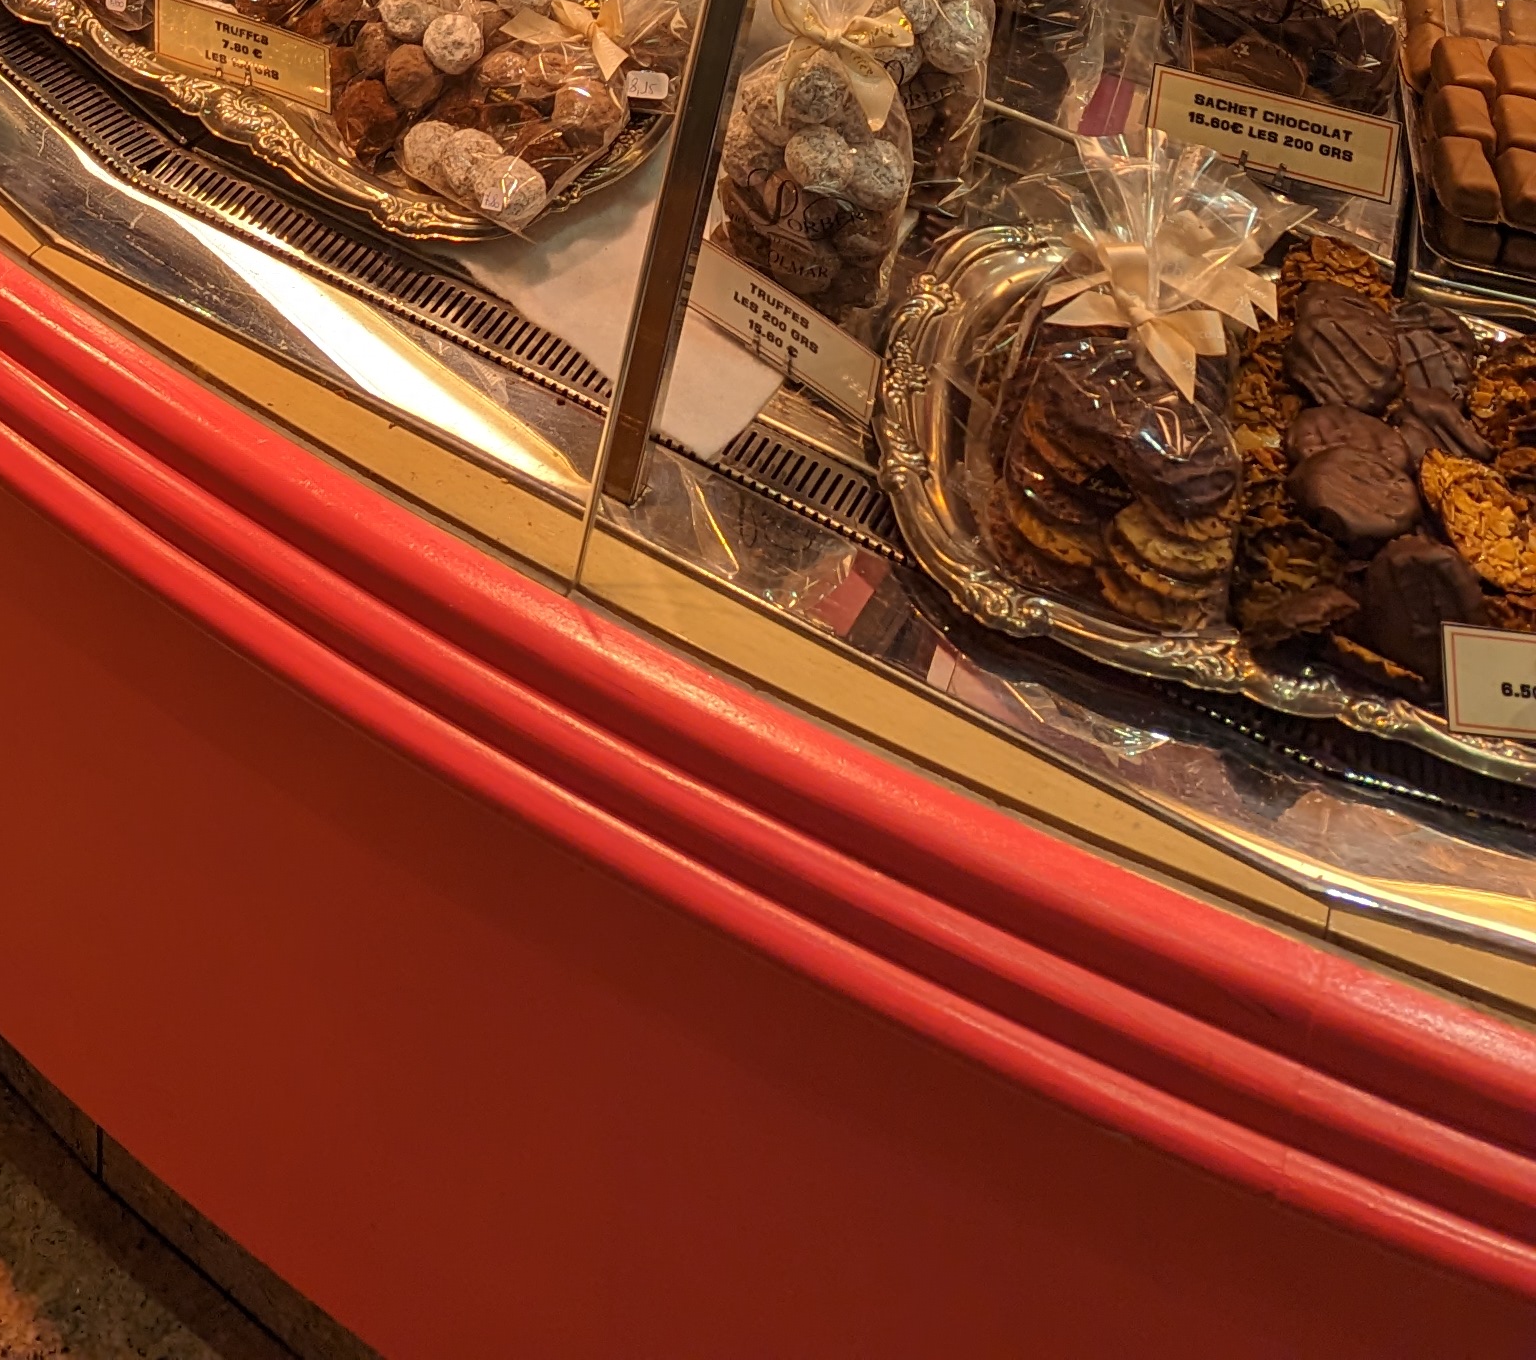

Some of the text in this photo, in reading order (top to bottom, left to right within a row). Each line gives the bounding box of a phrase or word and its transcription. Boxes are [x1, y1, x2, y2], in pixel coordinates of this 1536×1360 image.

[214, 20, 269, 46] TRUFFES
[252, 47, 263, 59] €
[204, 49, 228, 65] LES
[1188, 111, 1354, 163] 15.60€ LES 200 GRS
[1193, 93, 1353, 143] SACHET CHOCOLAT
[732, 291, 820, 355] LES 200 GRS
[750, 282, 810, 330] TRUFFES
[747, 318, 799, 359] 15.60 €
